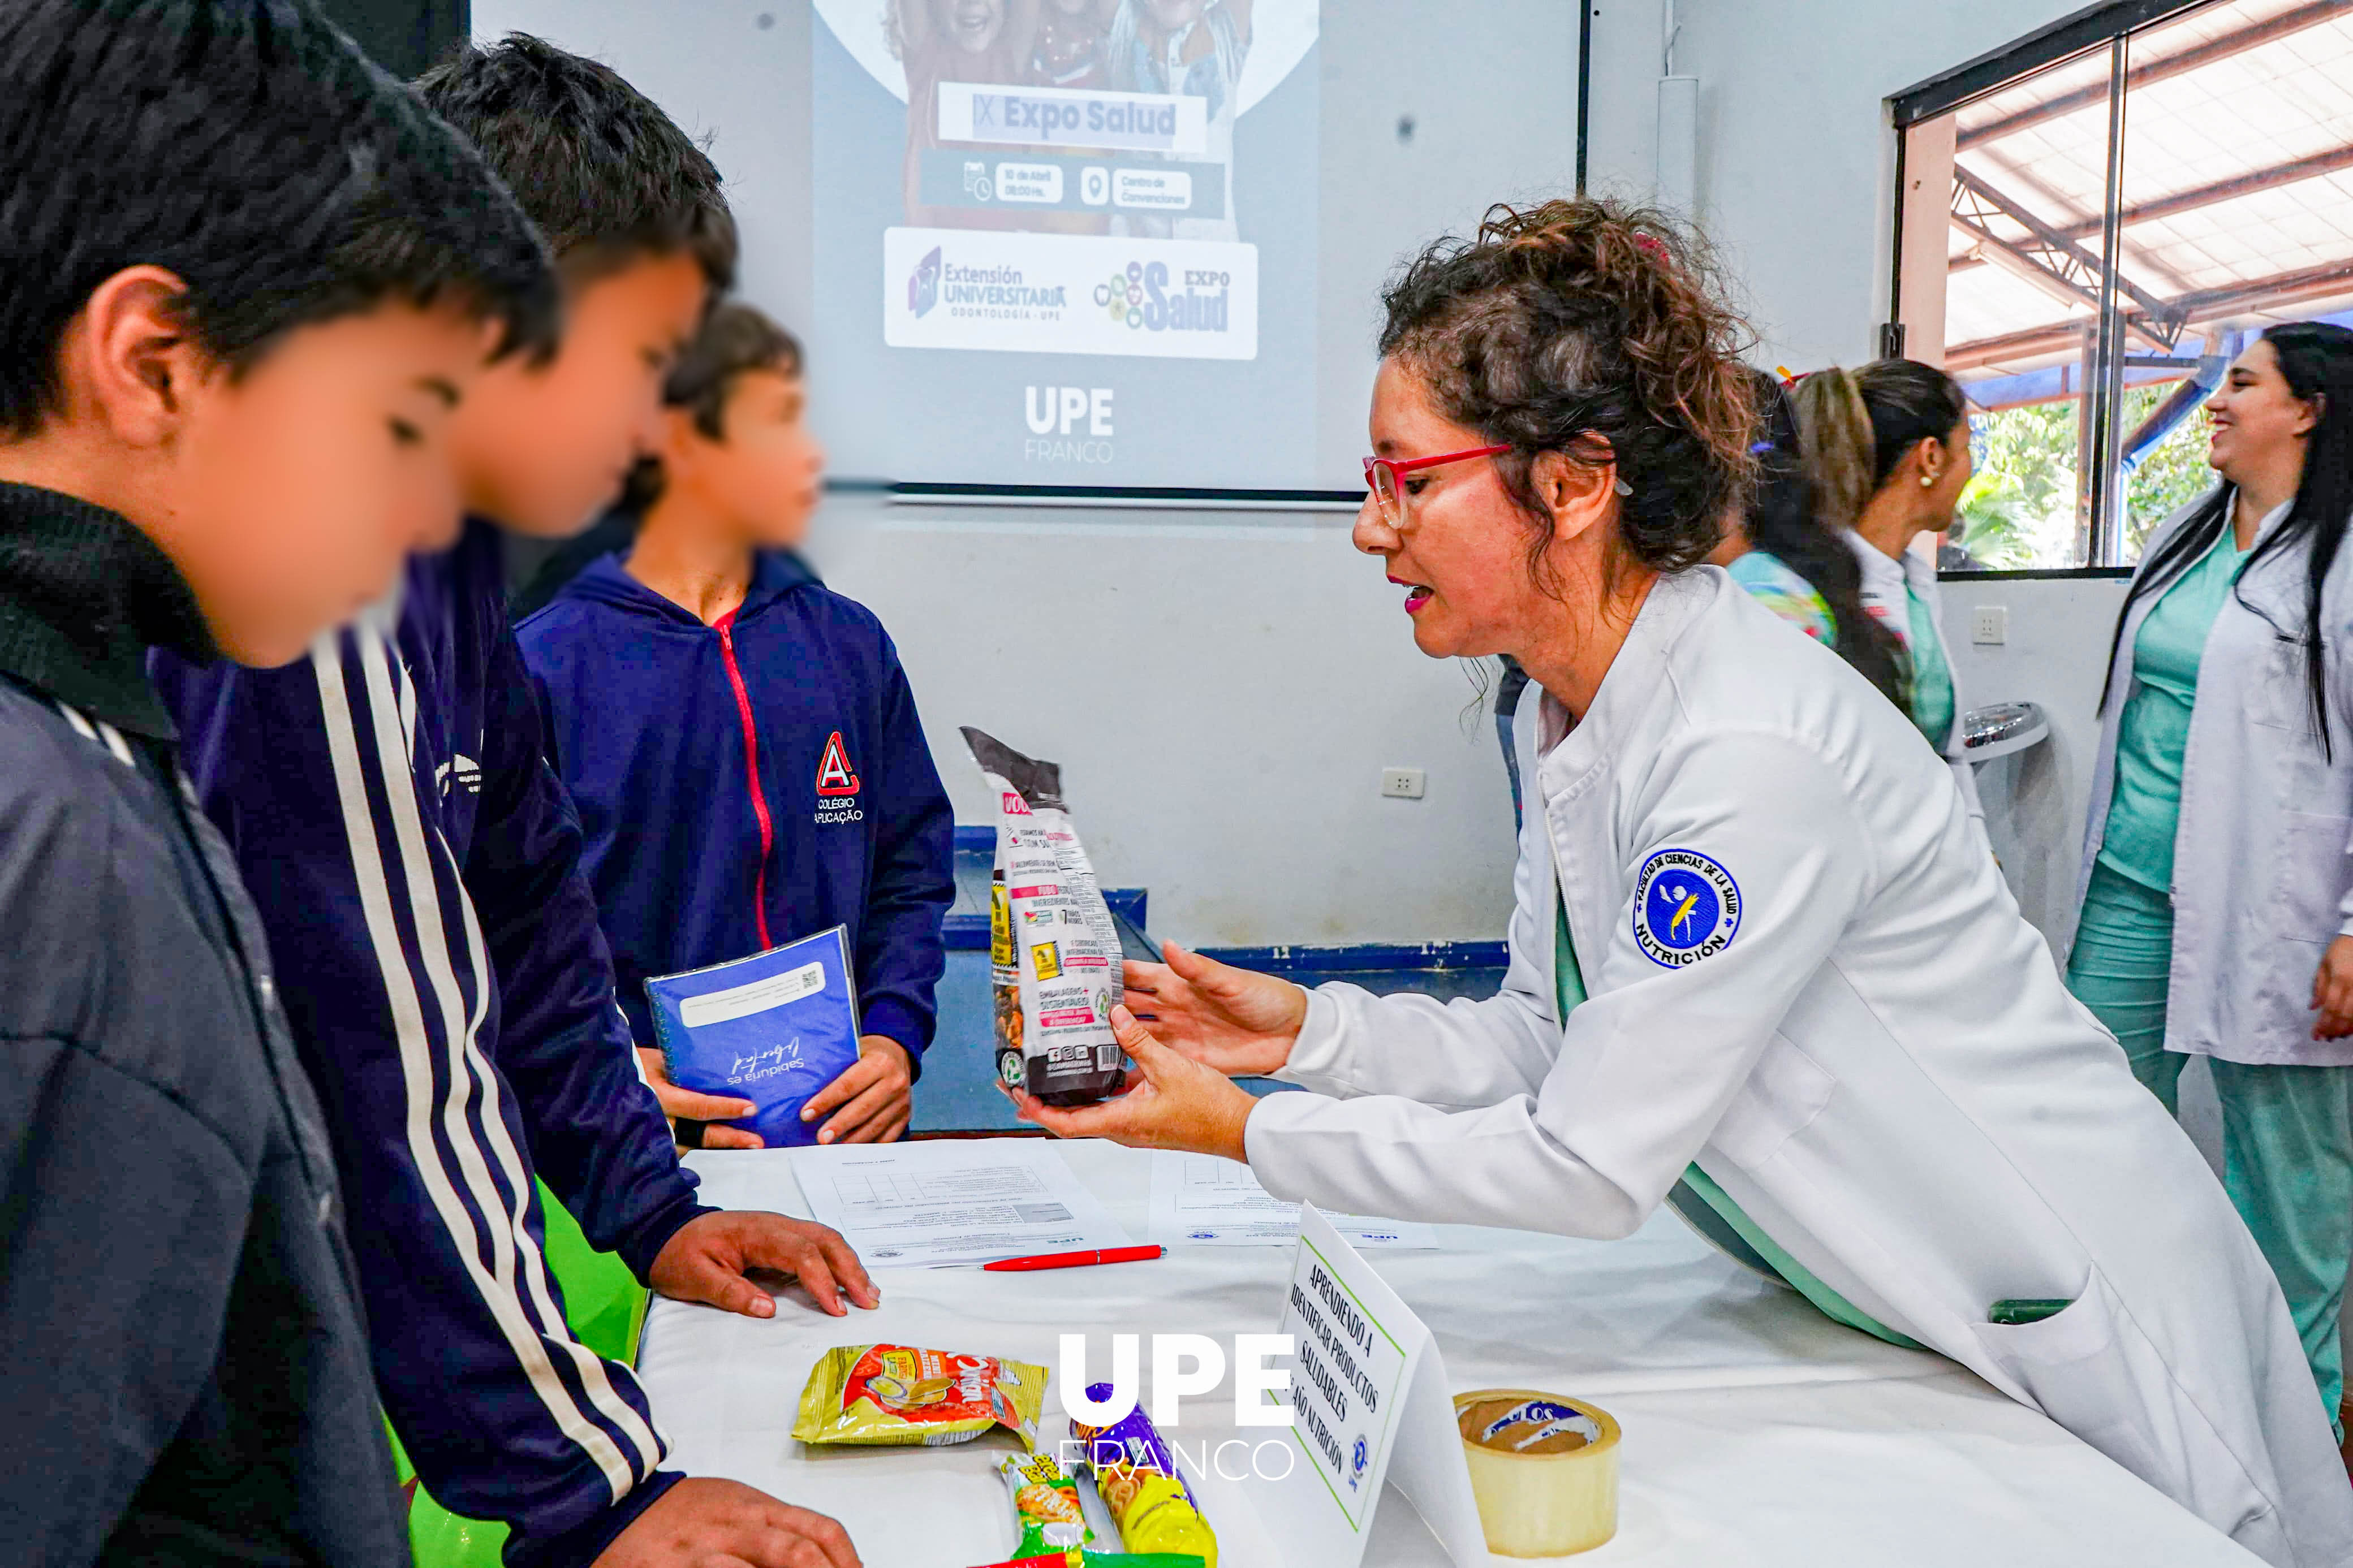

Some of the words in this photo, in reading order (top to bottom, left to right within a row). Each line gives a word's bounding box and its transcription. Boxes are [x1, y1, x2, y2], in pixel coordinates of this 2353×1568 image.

[1005, 96, 1080, 139] Expo
[1087, 100, 1176, 136] Salud
[1017, 170, 1029, 181] de
[1031, 170, 1051, 182] Abril
[1122, 176, 1153, 188] Centro
[1155, 178, 1165, 188] de
[1121, 192, 1186, 205] Convenciones
[945, 264, 1022, 284] Extensión
[1185, 270, 1230, 287] EXPO
[944, 284, 1066, 307] UNIVERSITARIA
[1144, 261, 1228, 331] Salud
[951, 307, 1031, 320] ODONTOLOGÍA
[1041, 310, 1060, 321] UPE
[1025, 386, 1113, 436] UPE
[1025, 439, 1114, 463] FRANCO
[818, 797, 855, 810] COLÉGIO
[1637, 863, 1656, 901] FACULTAD
[1654, 857, 1664, 869] DE
[1665, 854, 1704, 869] CIENCIAS
[1704, 864, 1718, 876] DE
[1714, 874, 1728, 887] LA
[1723, 887, 1737, 914] SALUD
[1636, 923, 1726, 965] NUTRICIÓN
[732, 1036, 799, 1075] libertad
[727, 1076, 742, 1085] es
[1309, 1264, 1365, 1346] APRENDIENDO
[1364, 1332, 1372, 1358] A
[1291, 1283, 1331, 1351] IDENTIFICAR
[1330, 1337, 1378, 1414] PRODUCTOS
[1300, 1340, 1347, 1422] SALUDABLES
[1292, 1385, 1307, 1416] AÑO
[1306, 1404, 1344, 1475] NUTRICIÓN
[1032, 1455, 1070, 1481] ereal
